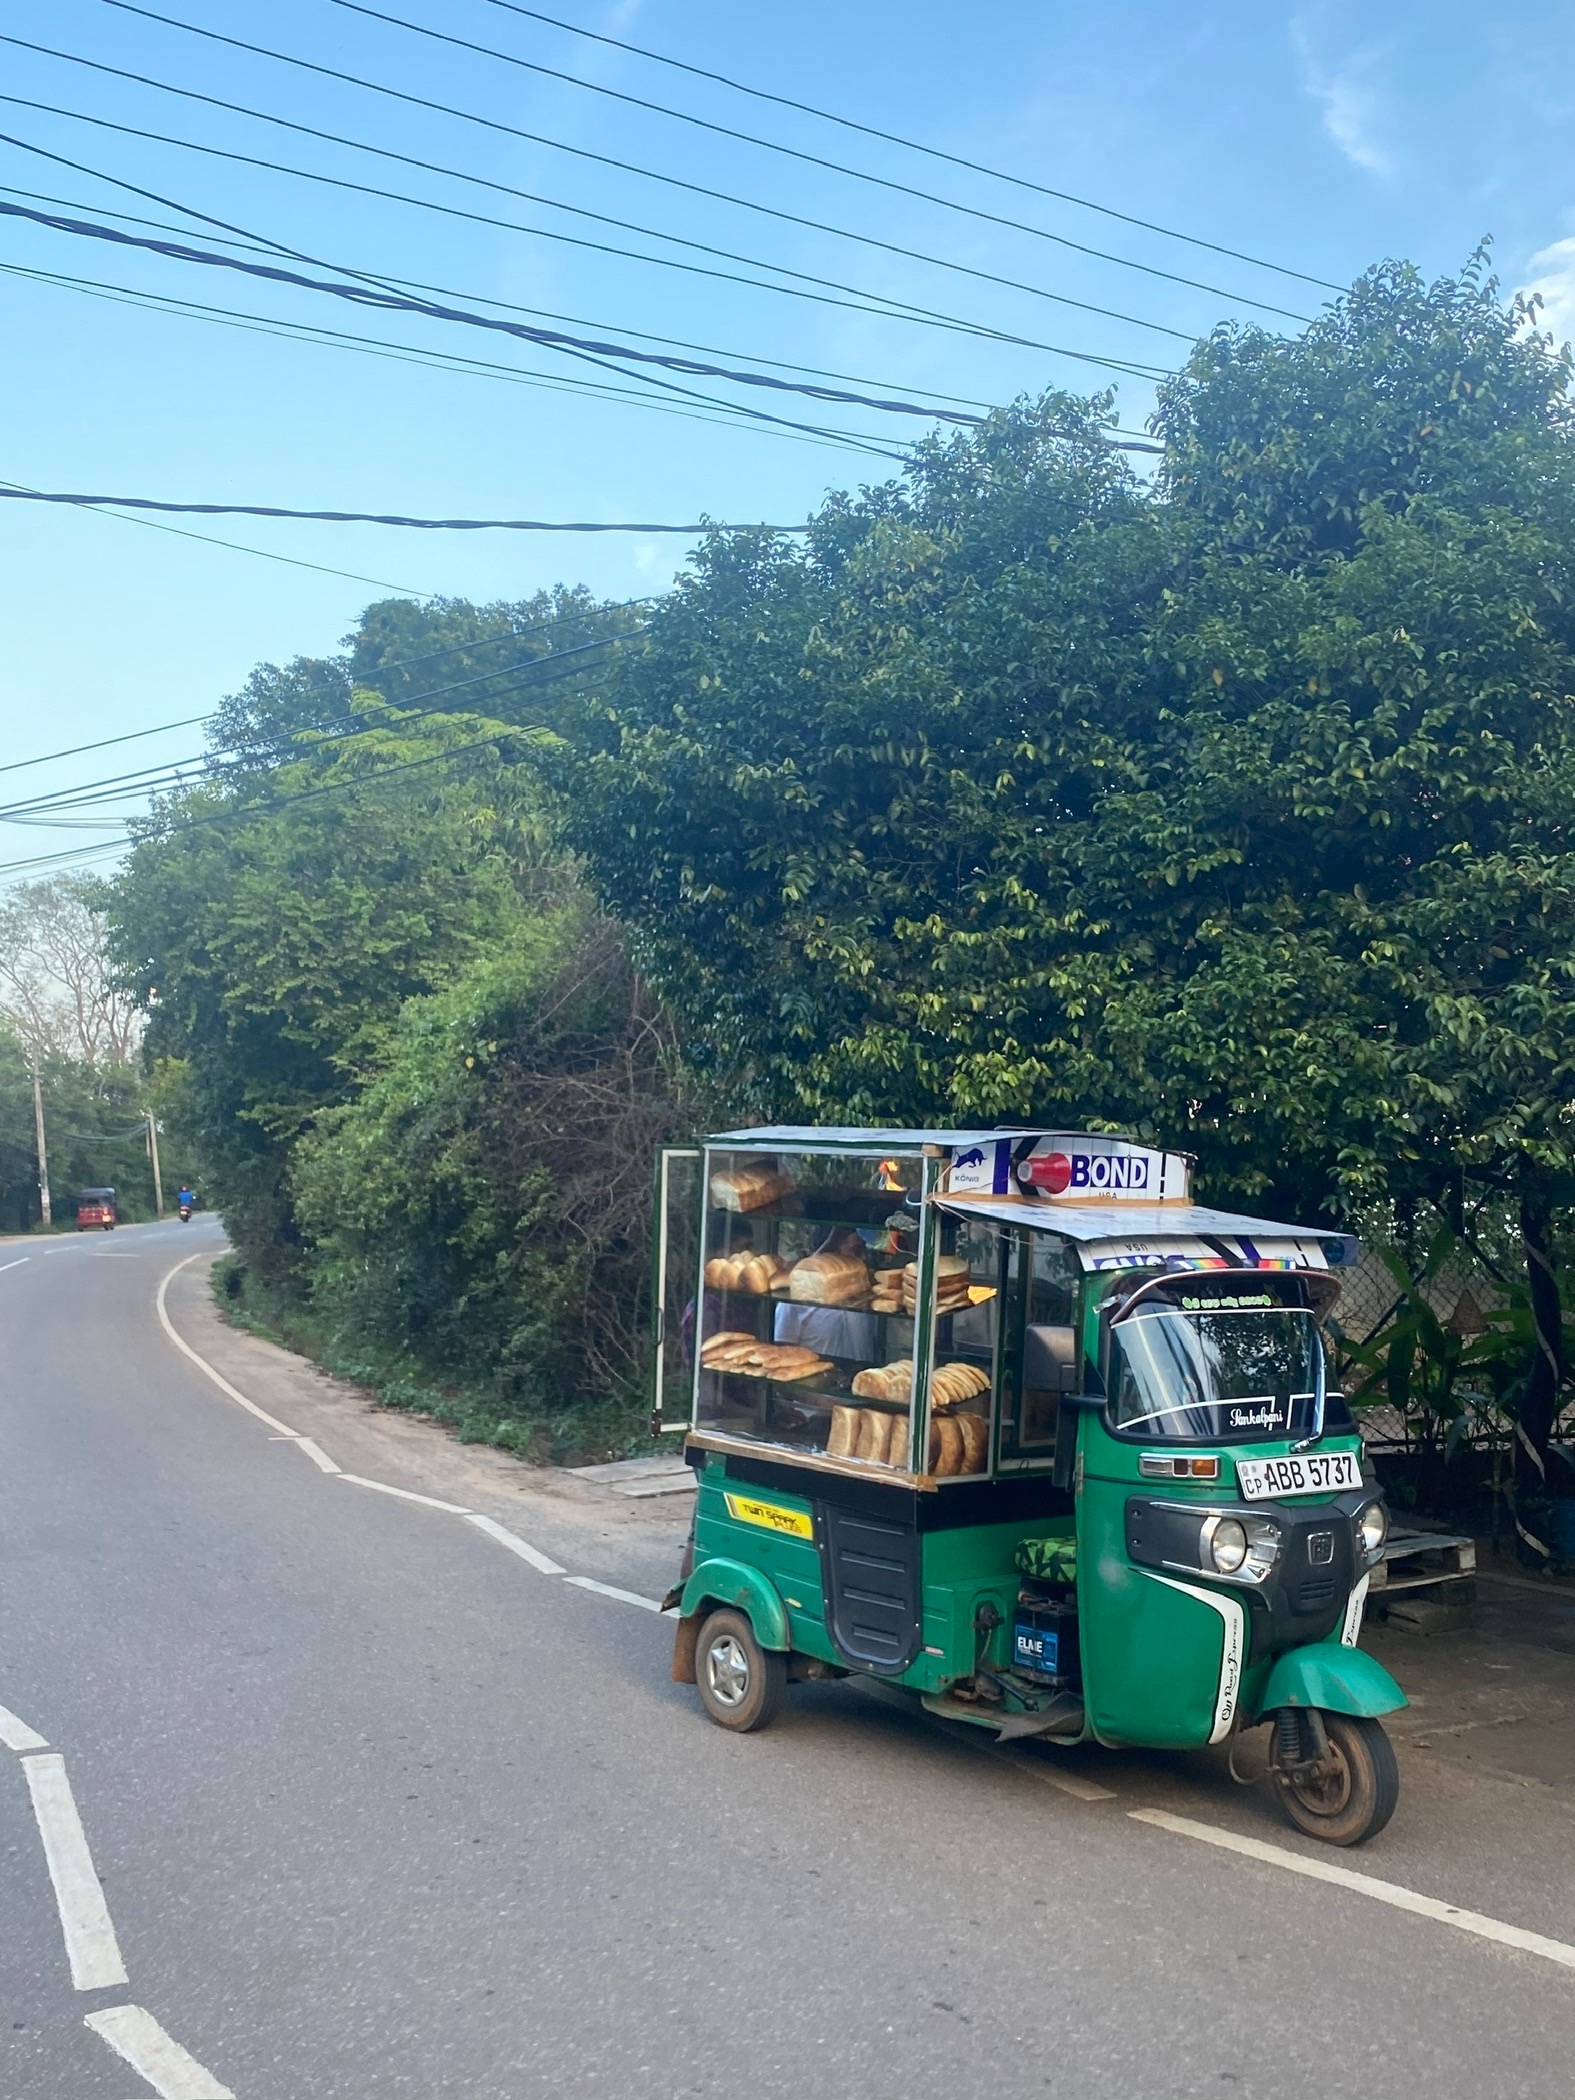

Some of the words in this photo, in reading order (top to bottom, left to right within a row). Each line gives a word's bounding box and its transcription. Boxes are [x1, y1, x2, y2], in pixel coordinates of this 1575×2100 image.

[1070, 1155, 1148, 1188] BOND
[1124, 1243, 1149, 1252] USA
[1265, 1461, 1305, 1492] ABB
[1307, 1456, 1353, 1487] 5737
